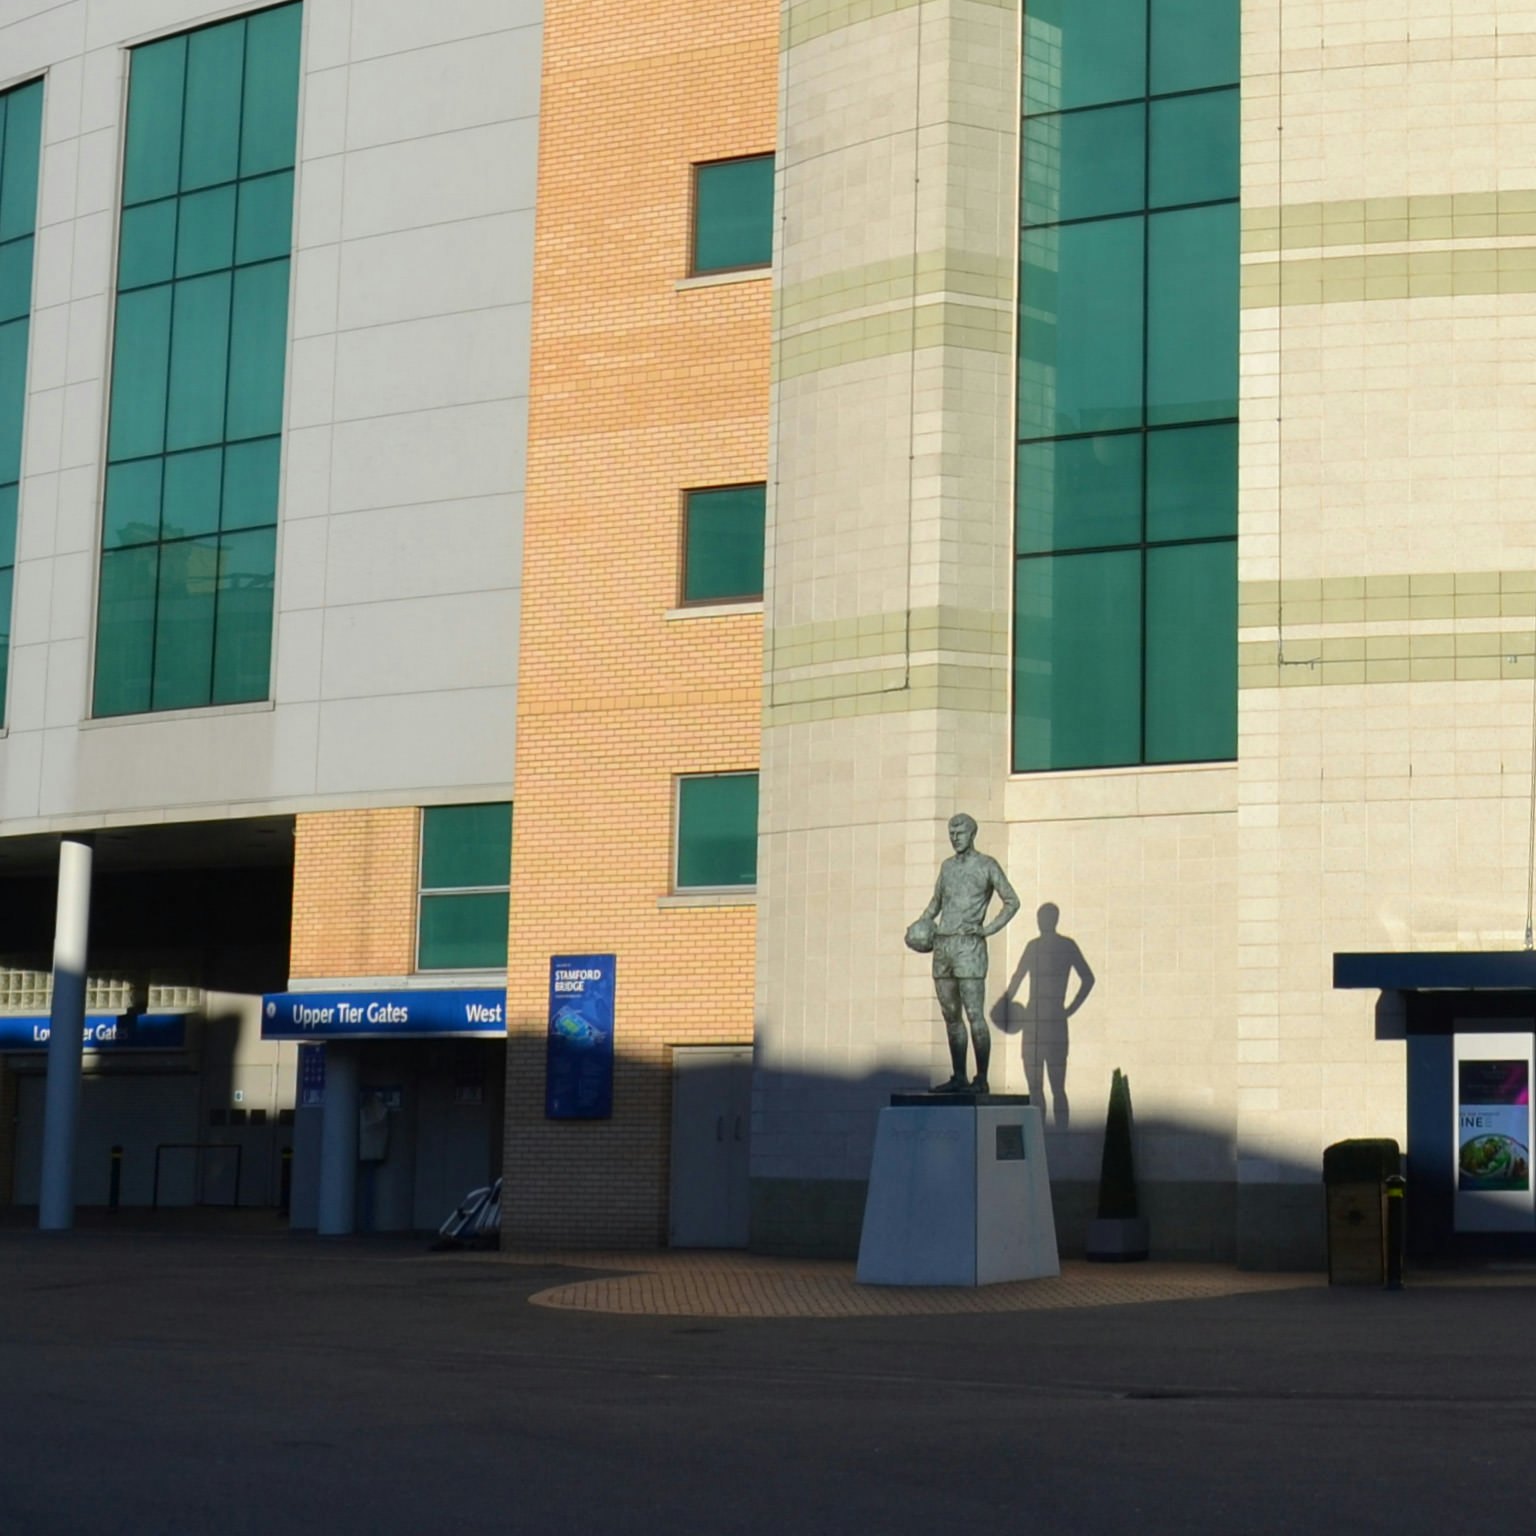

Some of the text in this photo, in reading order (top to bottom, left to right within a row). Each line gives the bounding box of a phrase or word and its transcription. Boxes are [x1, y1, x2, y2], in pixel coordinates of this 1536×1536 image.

[554, 969, 602, 981] STAMFORD
[292, 1002, 409, 1029] Upper Tier Gates
[465, 1002, 503, 1023] West
